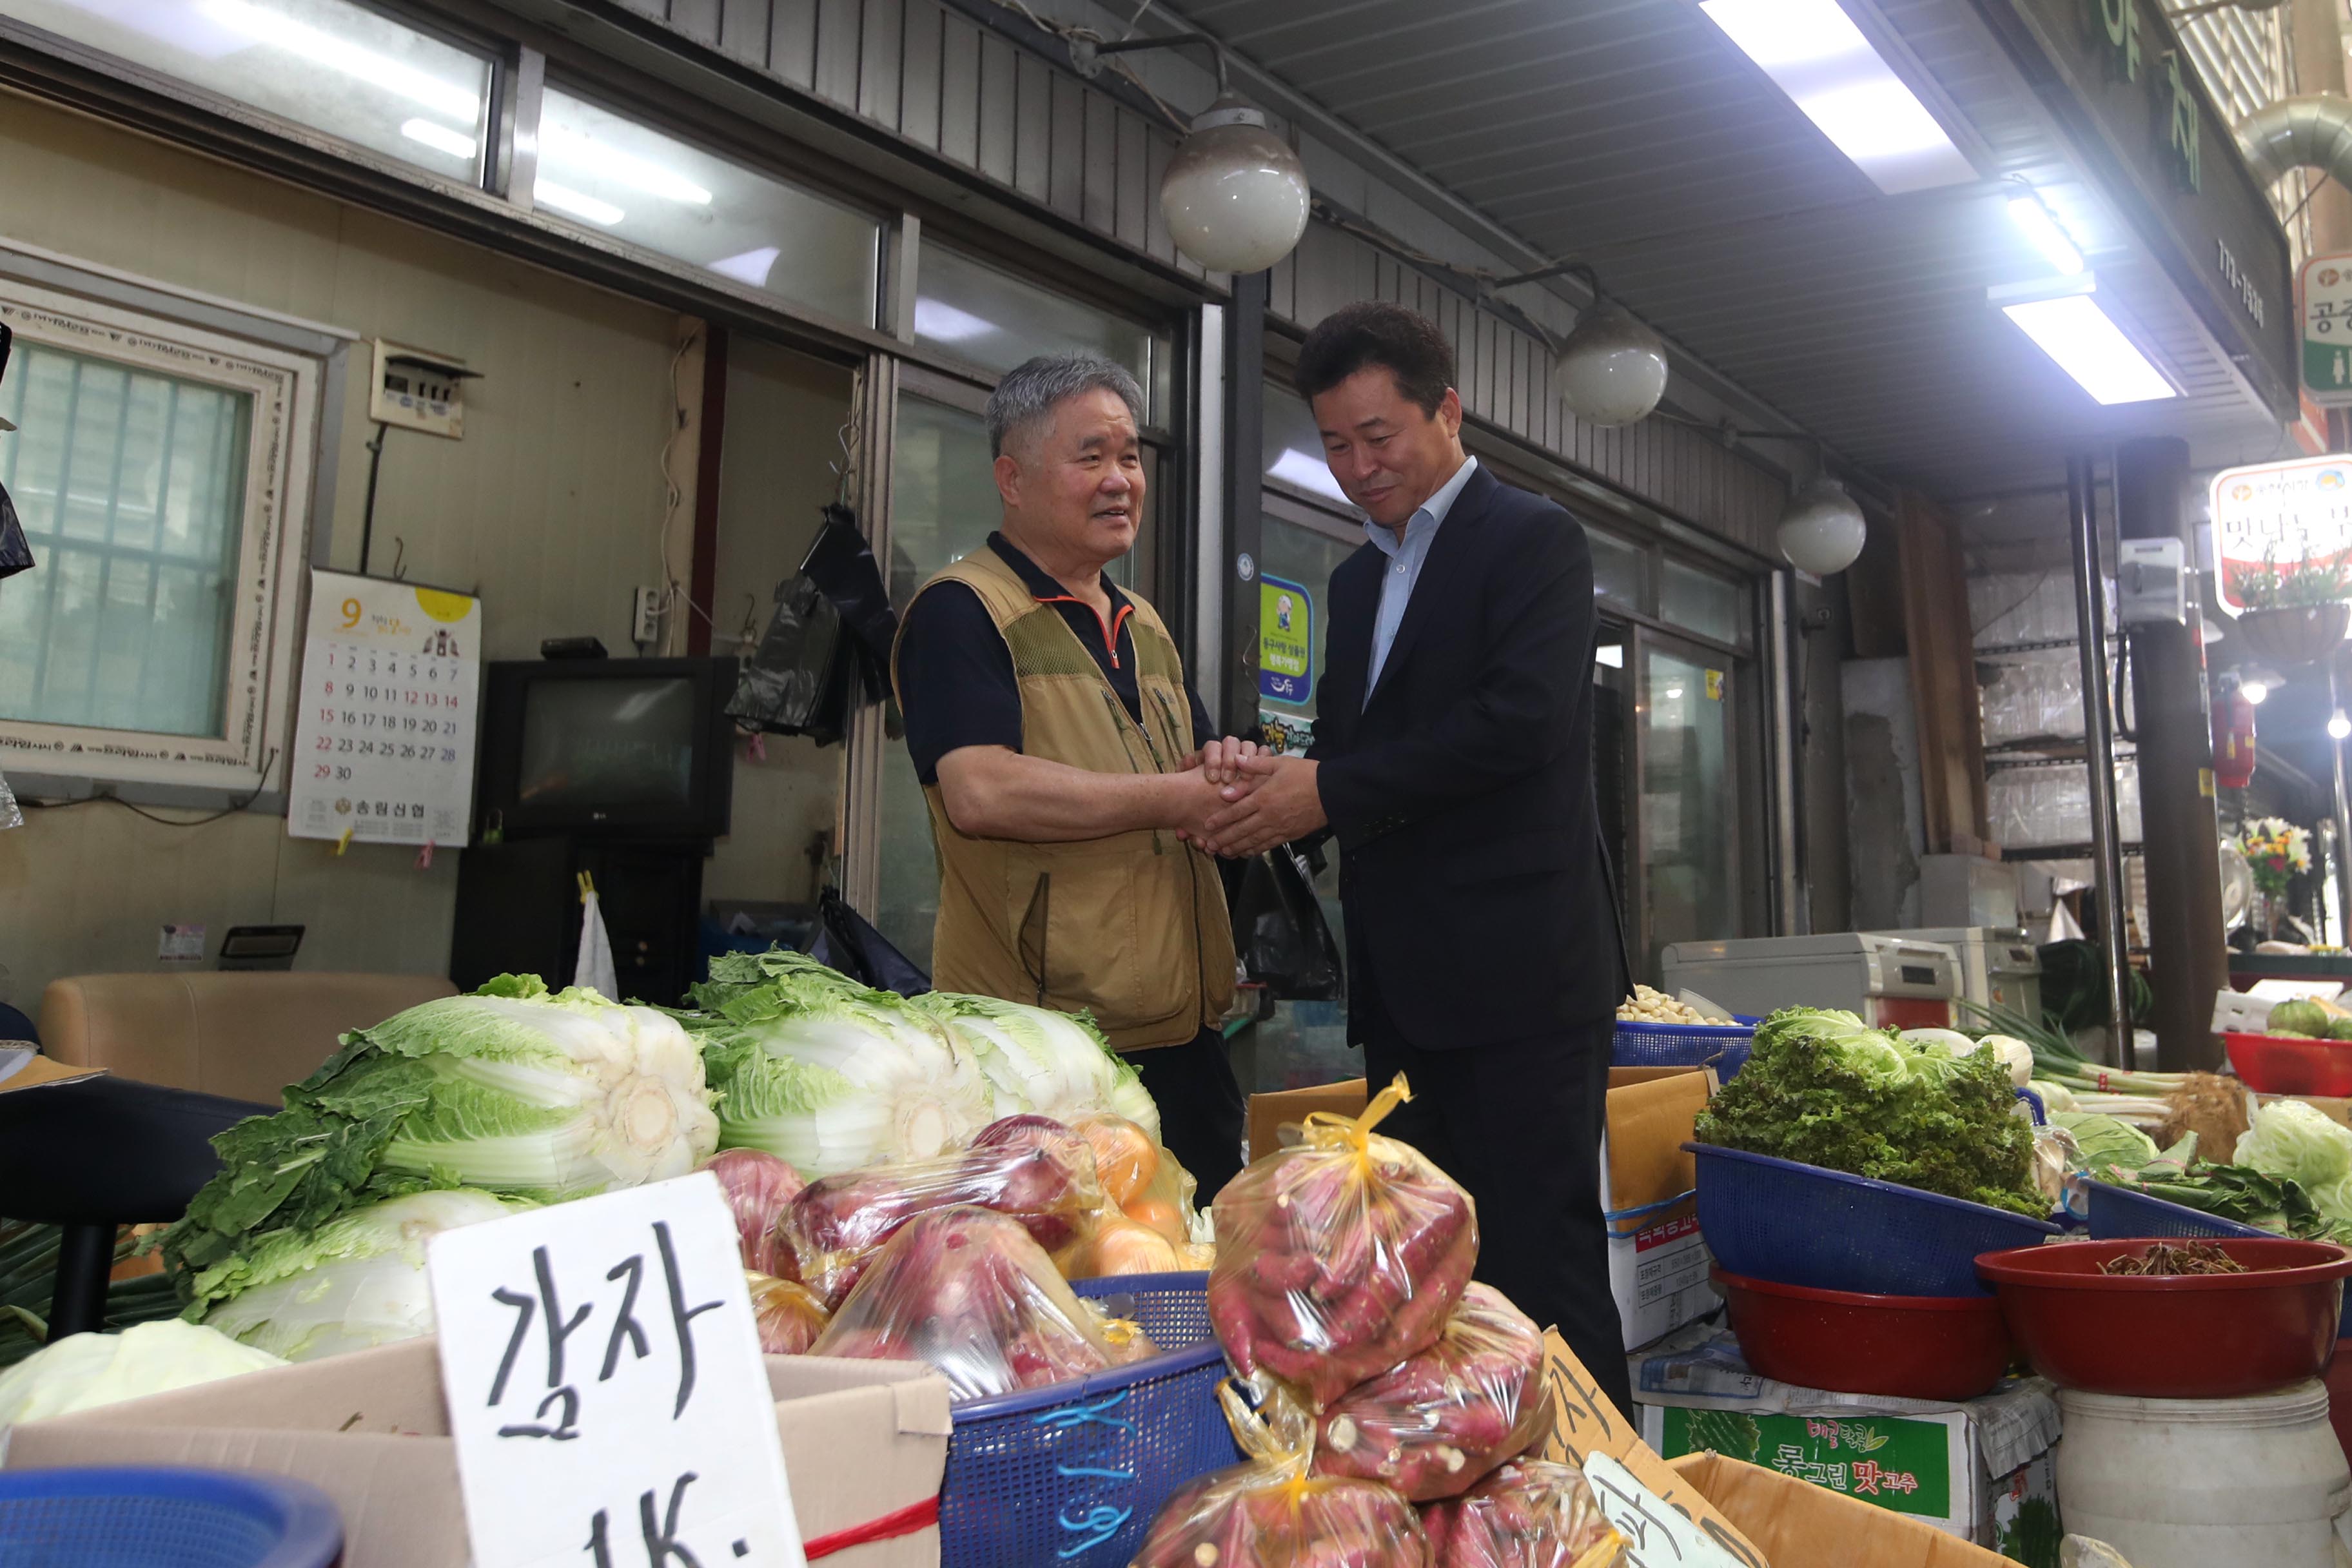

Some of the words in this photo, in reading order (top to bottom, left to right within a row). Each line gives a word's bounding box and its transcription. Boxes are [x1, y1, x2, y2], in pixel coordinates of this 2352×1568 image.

[341, 597, 362, 629] 9
[330, 653, 333, 665] 1
[349, 656, 355, 669] 2
[370, 659, 376, 672] 3
[389, 663, 396, 673] 4
[411, 665, 416, 676] 5
[429, 667, 437, 679] 6
[451, 669, 457, 681] 7
[325, 681, 333, 694] 8
[346, 684, 354, 696] 9
[364, 686, 377, 698] 10
[386, 690, 397, 701] 11
[406, 691, 418, 704] 12
[426, 693, 438, 705] 13
[445, 696, 458, 707] 14
[320, 709, 333, 721] 15
[342, 711, 355, 723] 16
[363, 714, 375, 725] 17
[383, 716, 396, 728] 18
[403, 718, 416, 730] 19
[422, 720, 436, 732] 20
[444, 723, 456, 734] 21
[316, 737, 331, 750] 22
[338, 739, 353, 752] 23
[359, 741, 373, 753] 24
[380, 743, 394, 756] 25
[400, 745, 415, 758] 26
[420, 747, 435, 760] 27
[441, 749, 455, 761] 28
[315, 765, 330, 778] 29
[336, 767, 351, 779] 30
[487, 1220, 725, 1440] 감자
